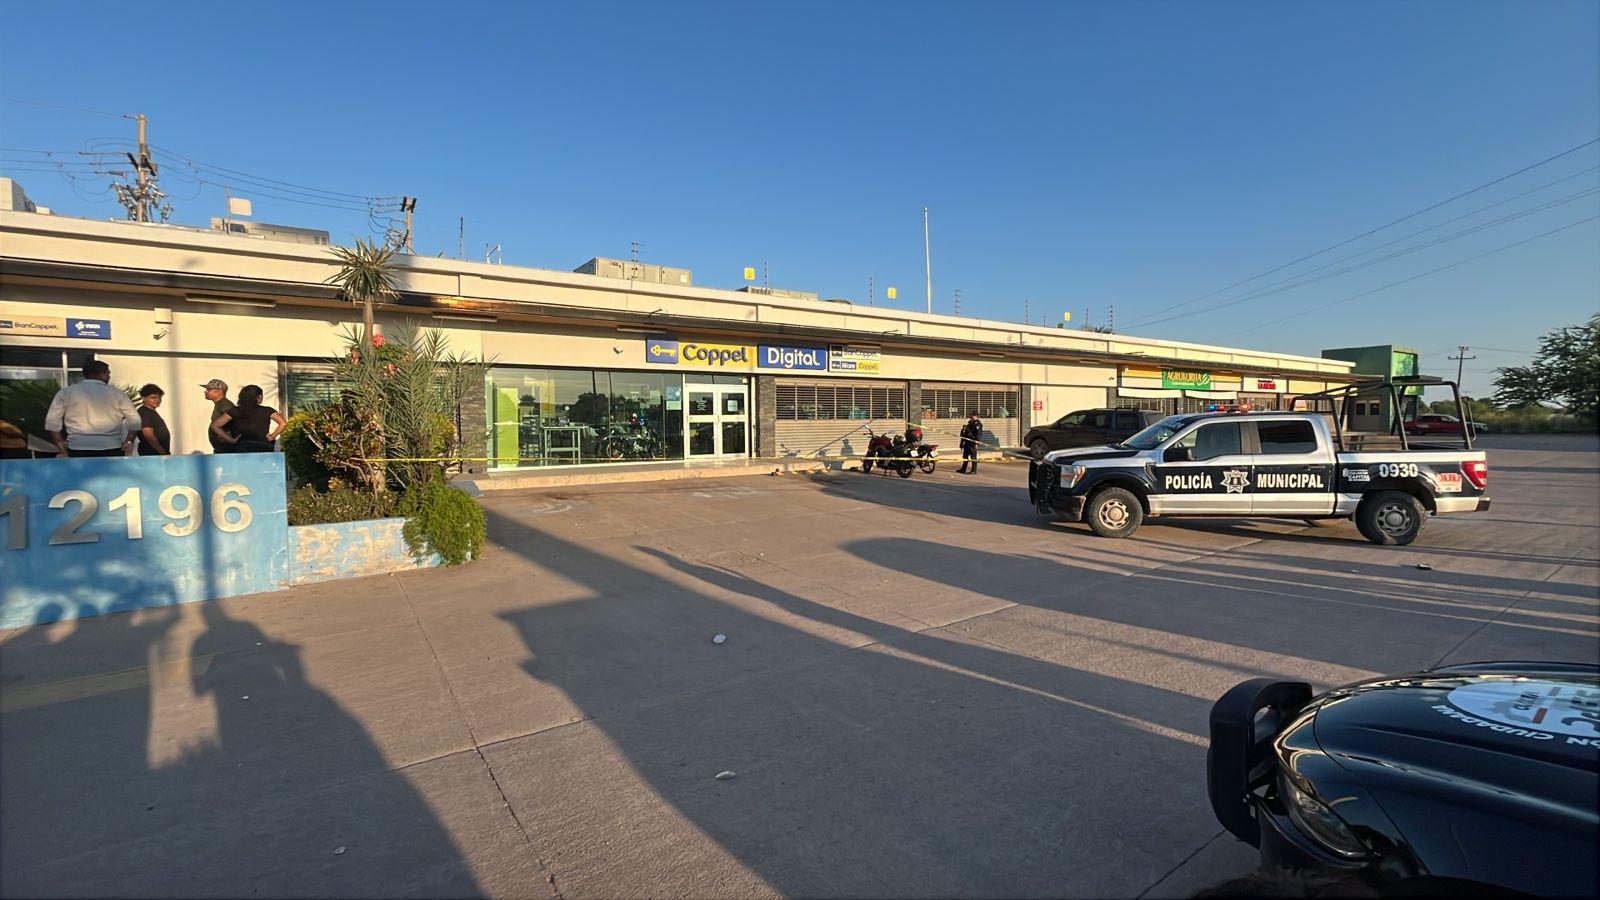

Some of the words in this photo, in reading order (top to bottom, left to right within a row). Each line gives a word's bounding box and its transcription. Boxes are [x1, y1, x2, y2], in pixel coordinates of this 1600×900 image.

[683, 344, 748, 366] Coppel
[767, 347, 820, 369] Digital
[1379, 463, 1418, 478] 0930
[1165, 472, 1213, 489] POLICÍA
[1257, 473, 1324, 488] MUNICIPAL
